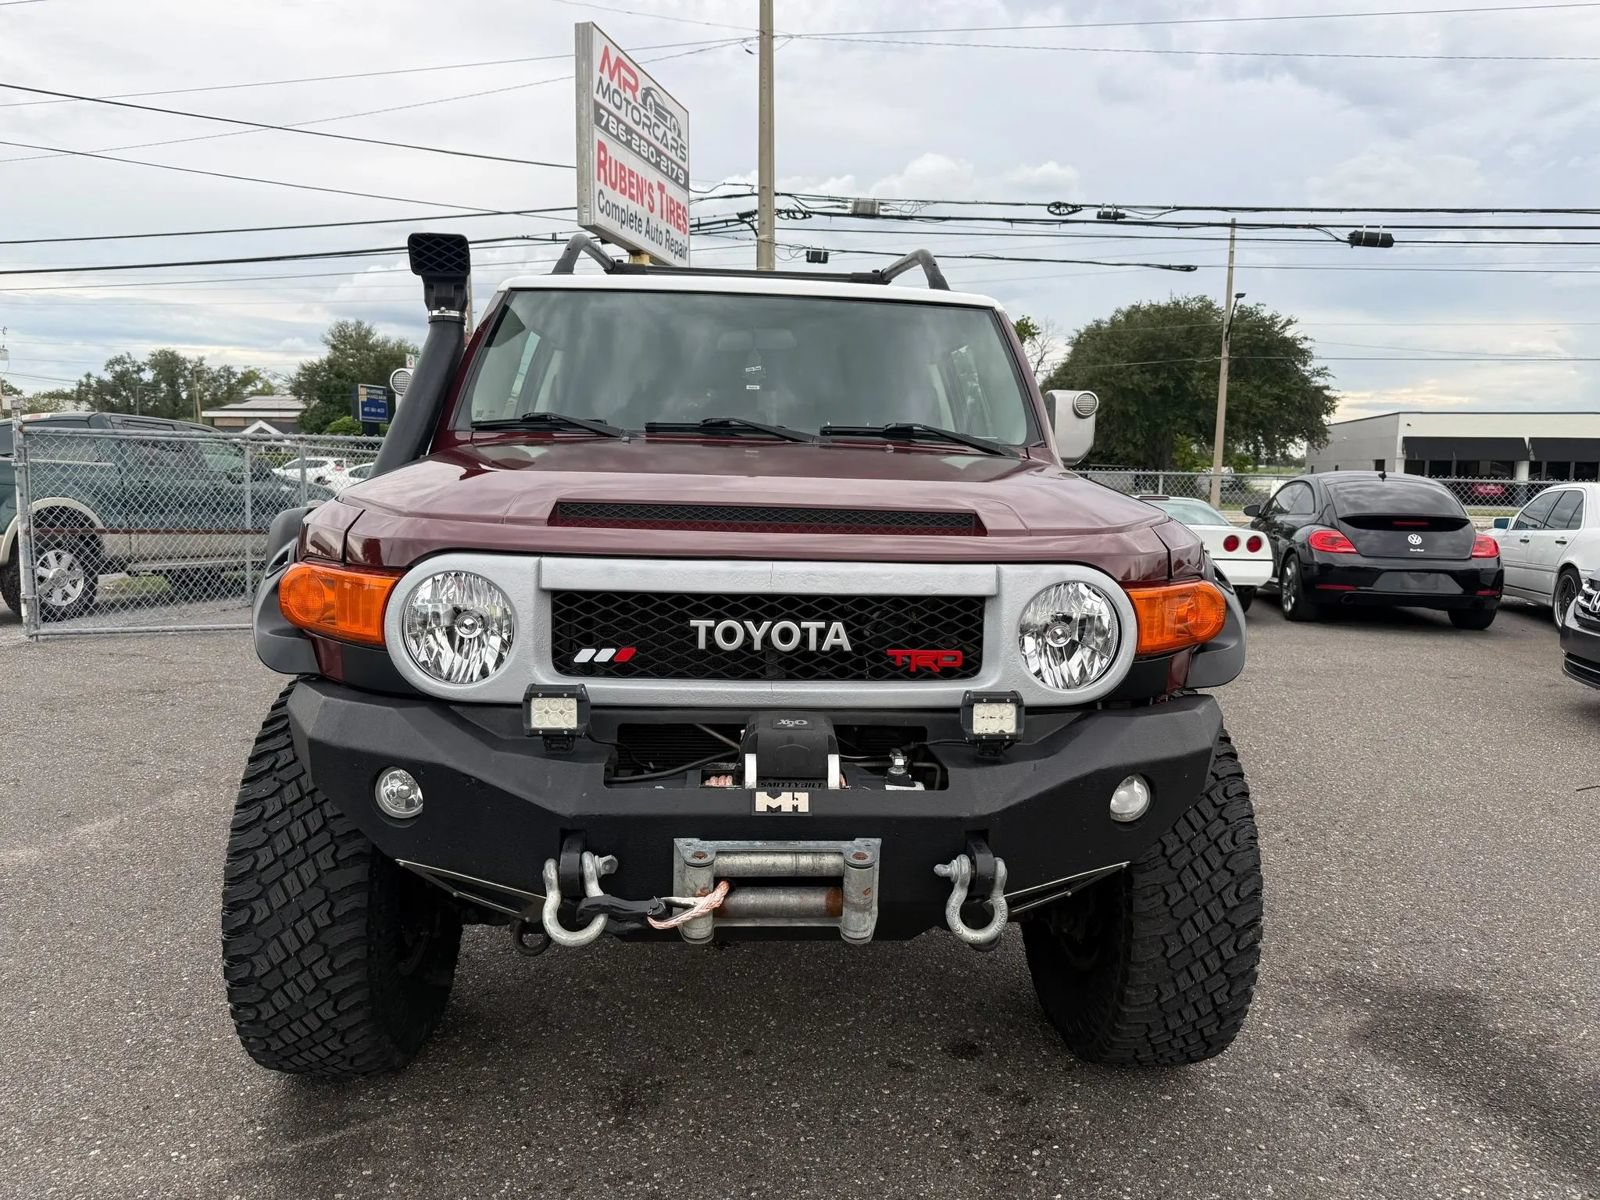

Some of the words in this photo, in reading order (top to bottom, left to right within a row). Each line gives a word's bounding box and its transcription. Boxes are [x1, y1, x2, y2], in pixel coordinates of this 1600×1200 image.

[599, 45, 638, 103] MR
[596, 76, 687, 163] MOTORCARS
[599, 109, 685, 185] 786-280-2179
[597, 139, 655, 213] RUBEN'S
[657, 180, 687, 235] TIRES
[597, 189, 643, 234] Complete
[645, 217, 663, 247] Auto
[665, 229, 688, 261] Repair
[689, 619, 852, 651] TOYOTA
[886, 649, 964, 673] TRD
